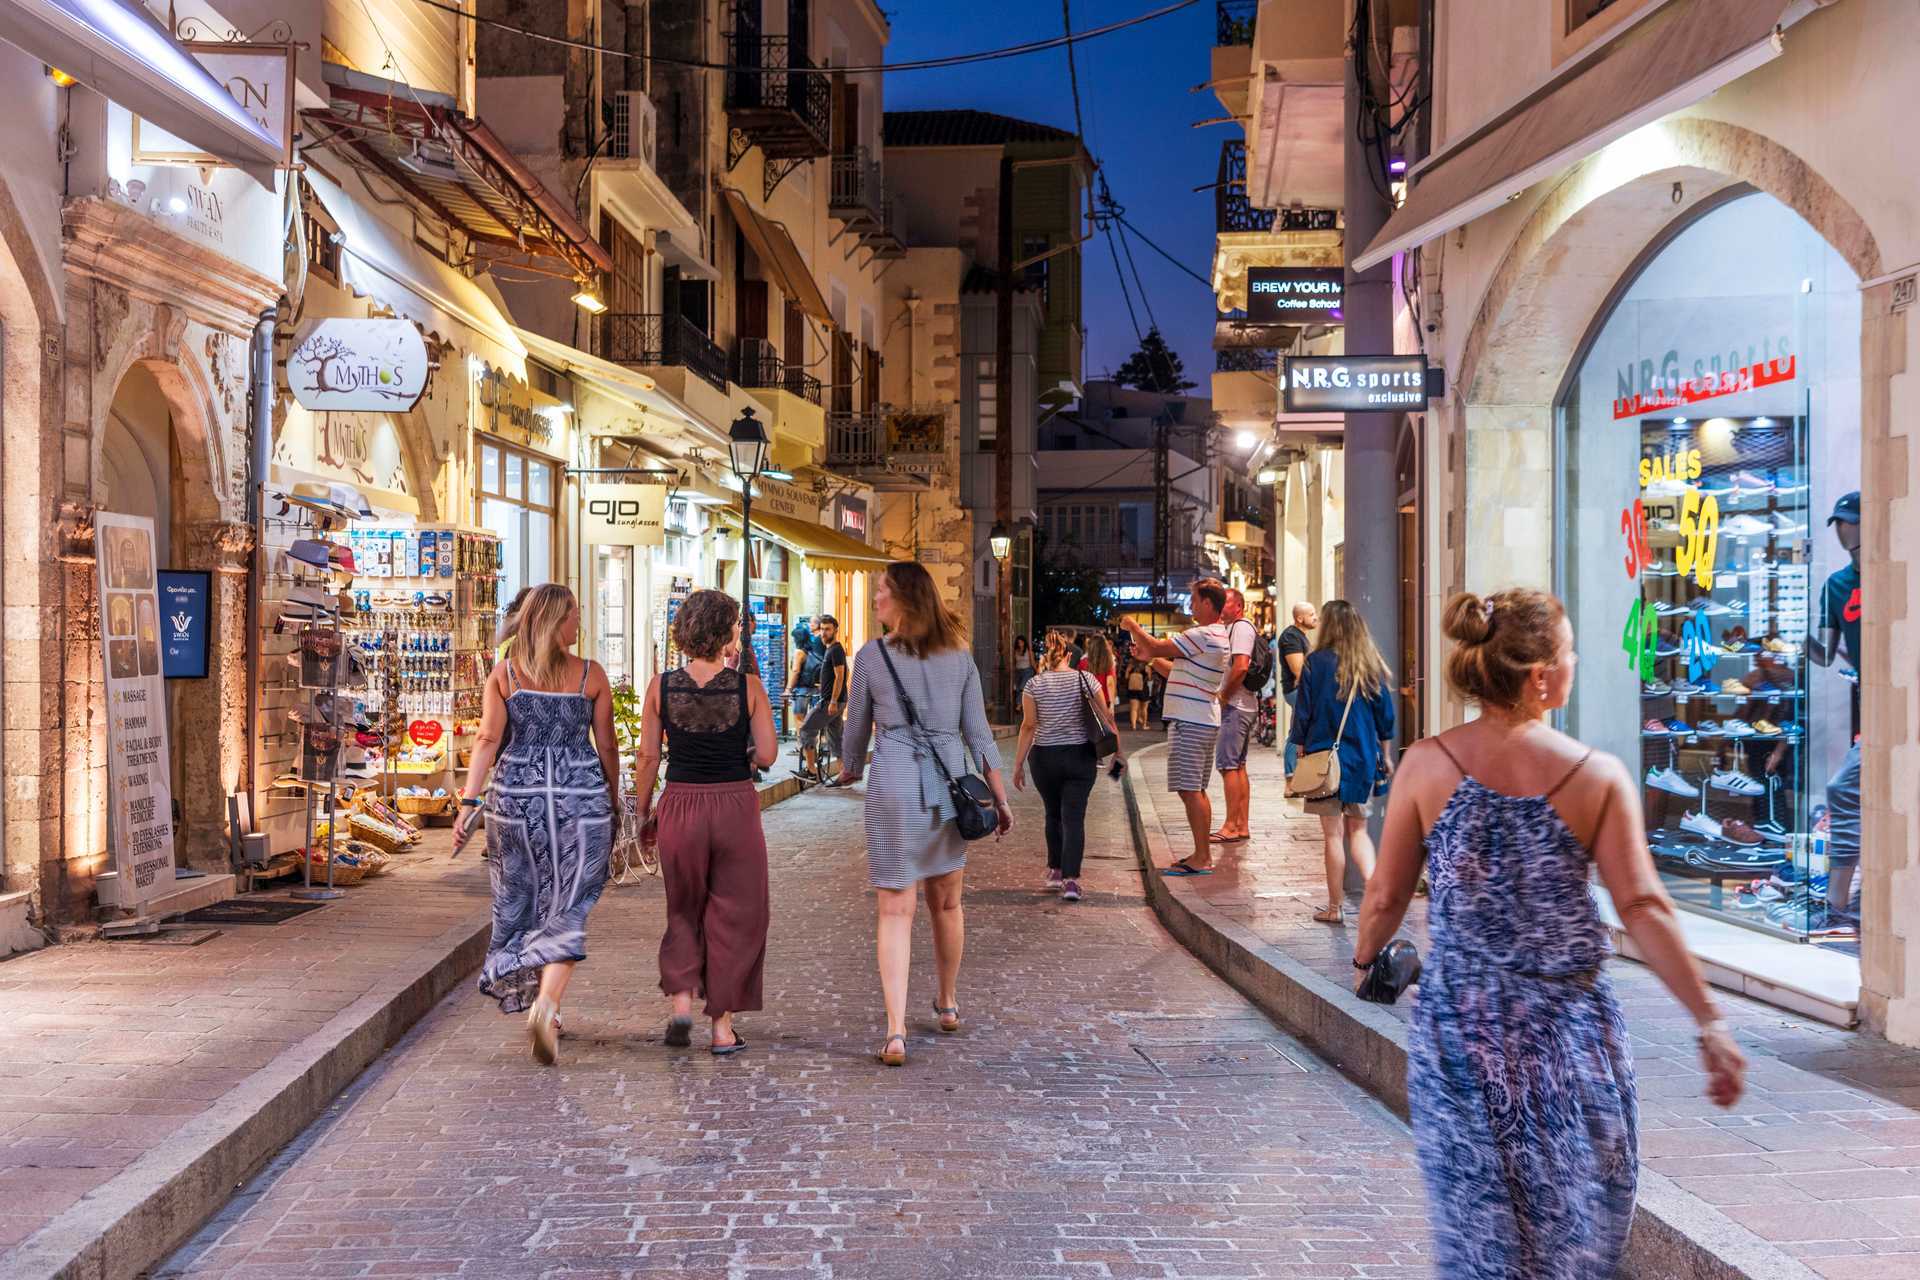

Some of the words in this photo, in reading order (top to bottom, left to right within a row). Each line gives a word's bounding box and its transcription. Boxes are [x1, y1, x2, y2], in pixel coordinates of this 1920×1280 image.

[1252, 282, 1291, 293] BREW
[1293, 282, 1330, 293] YOUR
[1277, 299, 1307, 309] Coffee
[1309, 299, 1340, 309] School
[1357, 371, 1422, 388] sports
[1368, 391, 1422, 403] exclusive
[1639, 449, 1702, 487] SALES
[617, 517, 660, 528] sunglasses
[123, 689, 147, 703] MASSAGE
[124, 716, 147, 729] HAMMAM
[126, 738, 143, 752] FACIAL
[148, 736, 162, 750] BODY
[127, 751, 158, 767] TREATMENTS
[128, 773, 149, 787] WAXING
[130, 796, 155, 811] MANICURE
[130, 808, 155, 824] PEDICURE
[133, 838, 162, 856] EXTENSIONS
[134, 856, 169, 875] PROFESSIONAL
[135, 872, 155, 888] MAKEUP
